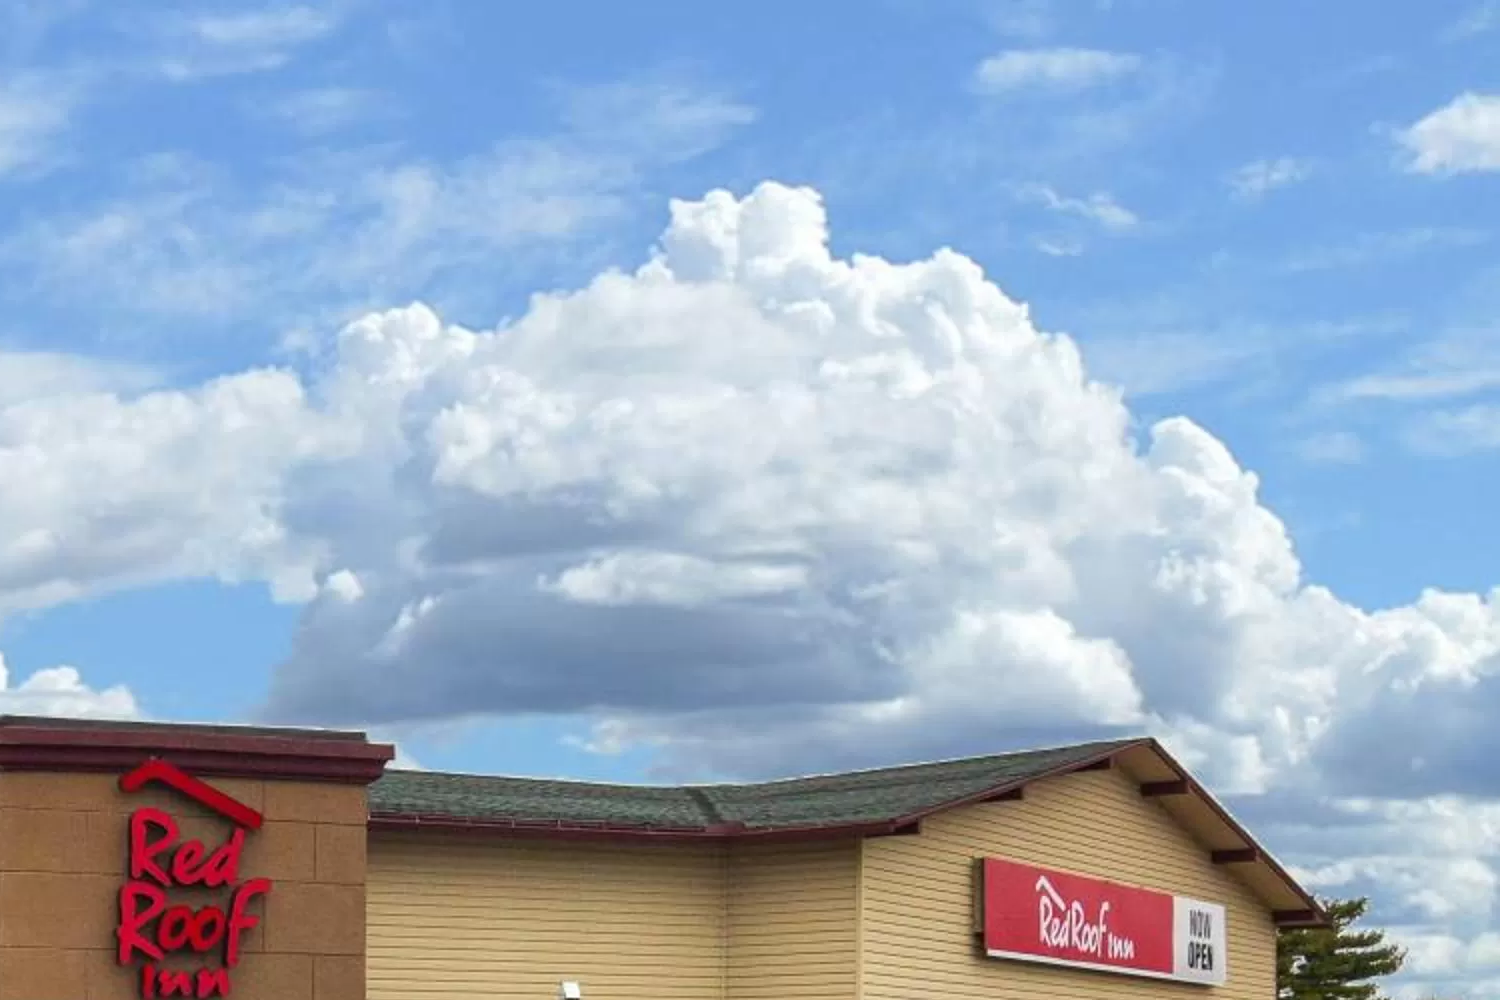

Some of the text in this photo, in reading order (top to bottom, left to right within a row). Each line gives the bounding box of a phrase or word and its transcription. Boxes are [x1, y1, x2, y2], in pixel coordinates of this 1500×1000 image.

[130, 808, 246, 888] Red
[117, 878, 273, 969] Roof
[1189, 909, 1212, 939] NOW
[1107, 931, 1135, 960] Inn
[1187, 941, 1213, 971] OPEN
